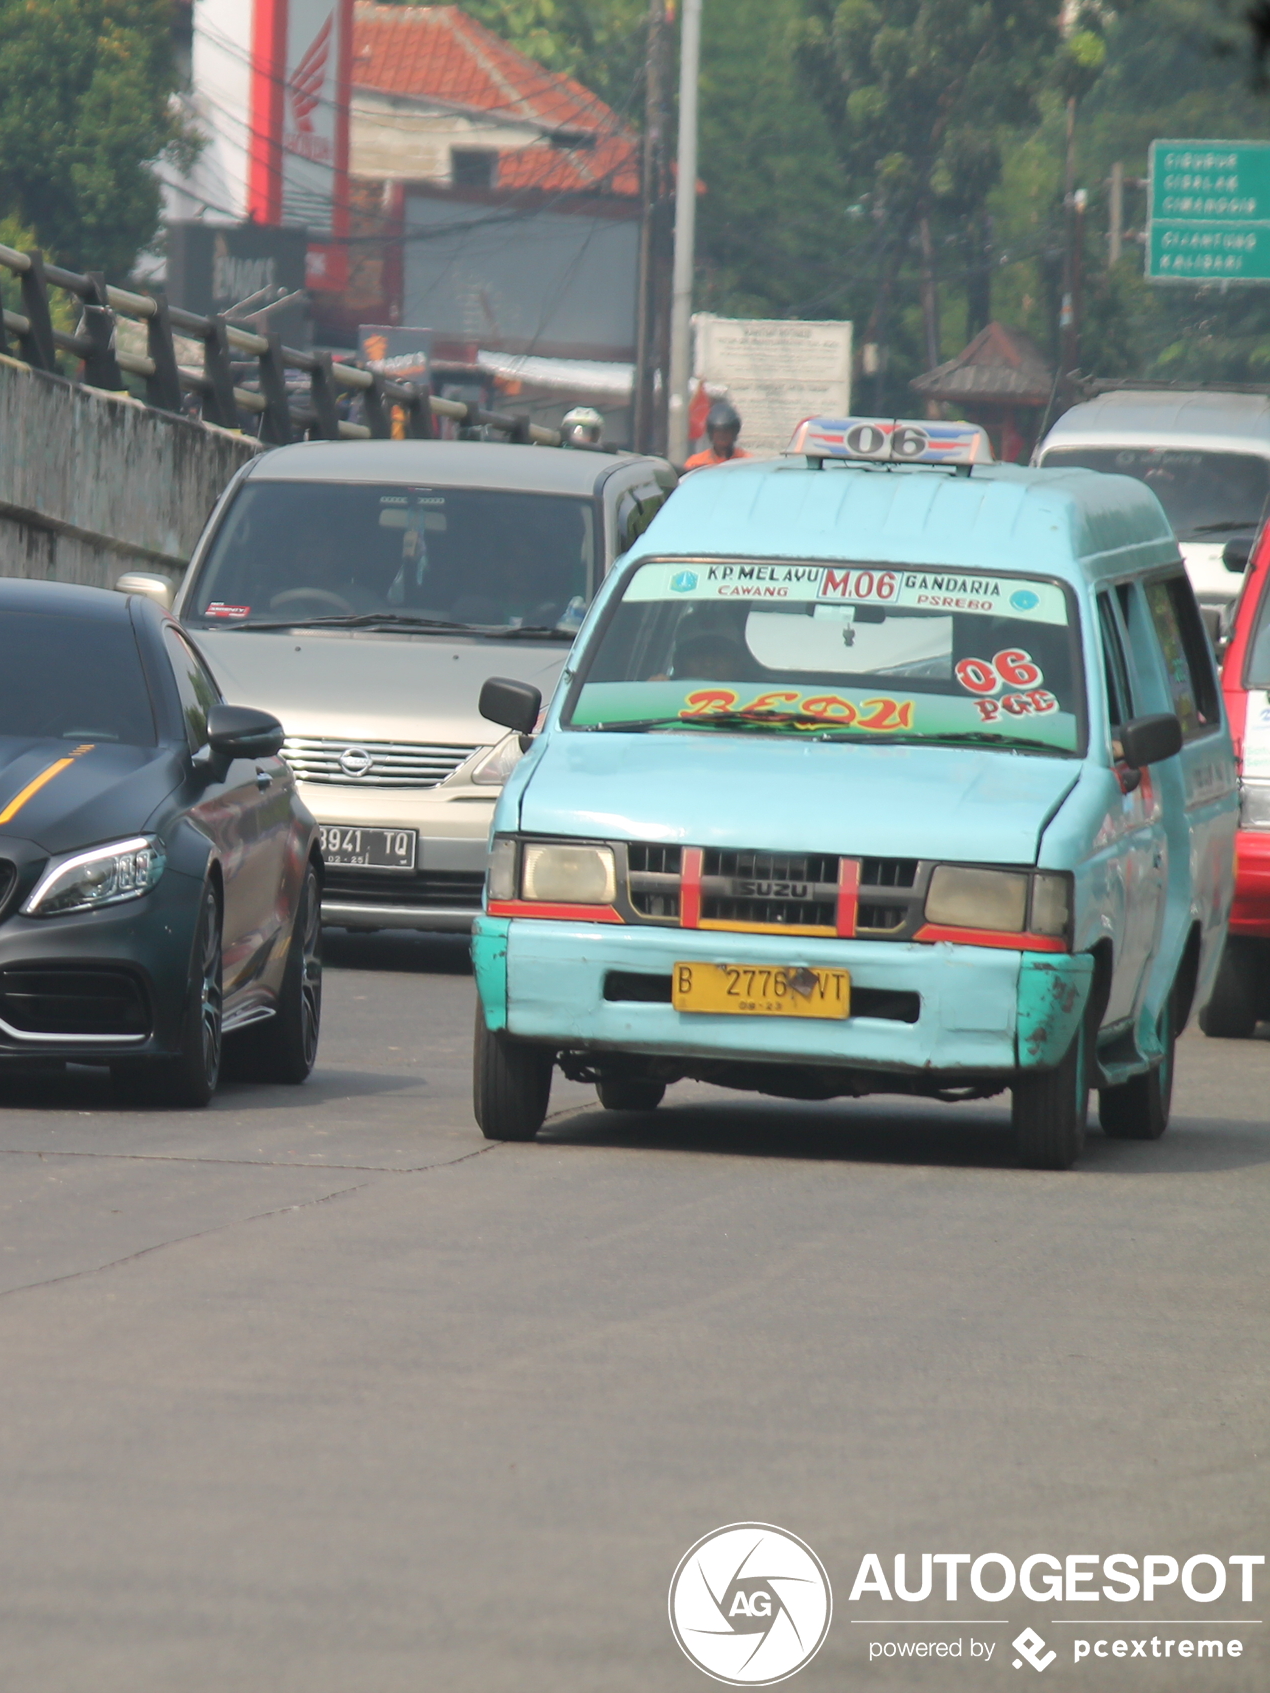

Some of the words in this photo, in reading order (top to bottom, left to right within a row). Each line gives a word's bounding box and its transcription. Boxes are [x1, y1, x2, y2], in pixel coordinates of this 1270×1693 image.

[846, 424, 928, 456] 06
[717, 585, 789, 597] CAWANG
[905, 575, 1001, 597] GANDARIA
[917, 594, 993, 611] PSREBO
[955, 649, 1044, 694] 06
[383, 832, 408, 856] TQ
[678, 967, 692, 993] B
[727, 970, 788, 997] 2776
